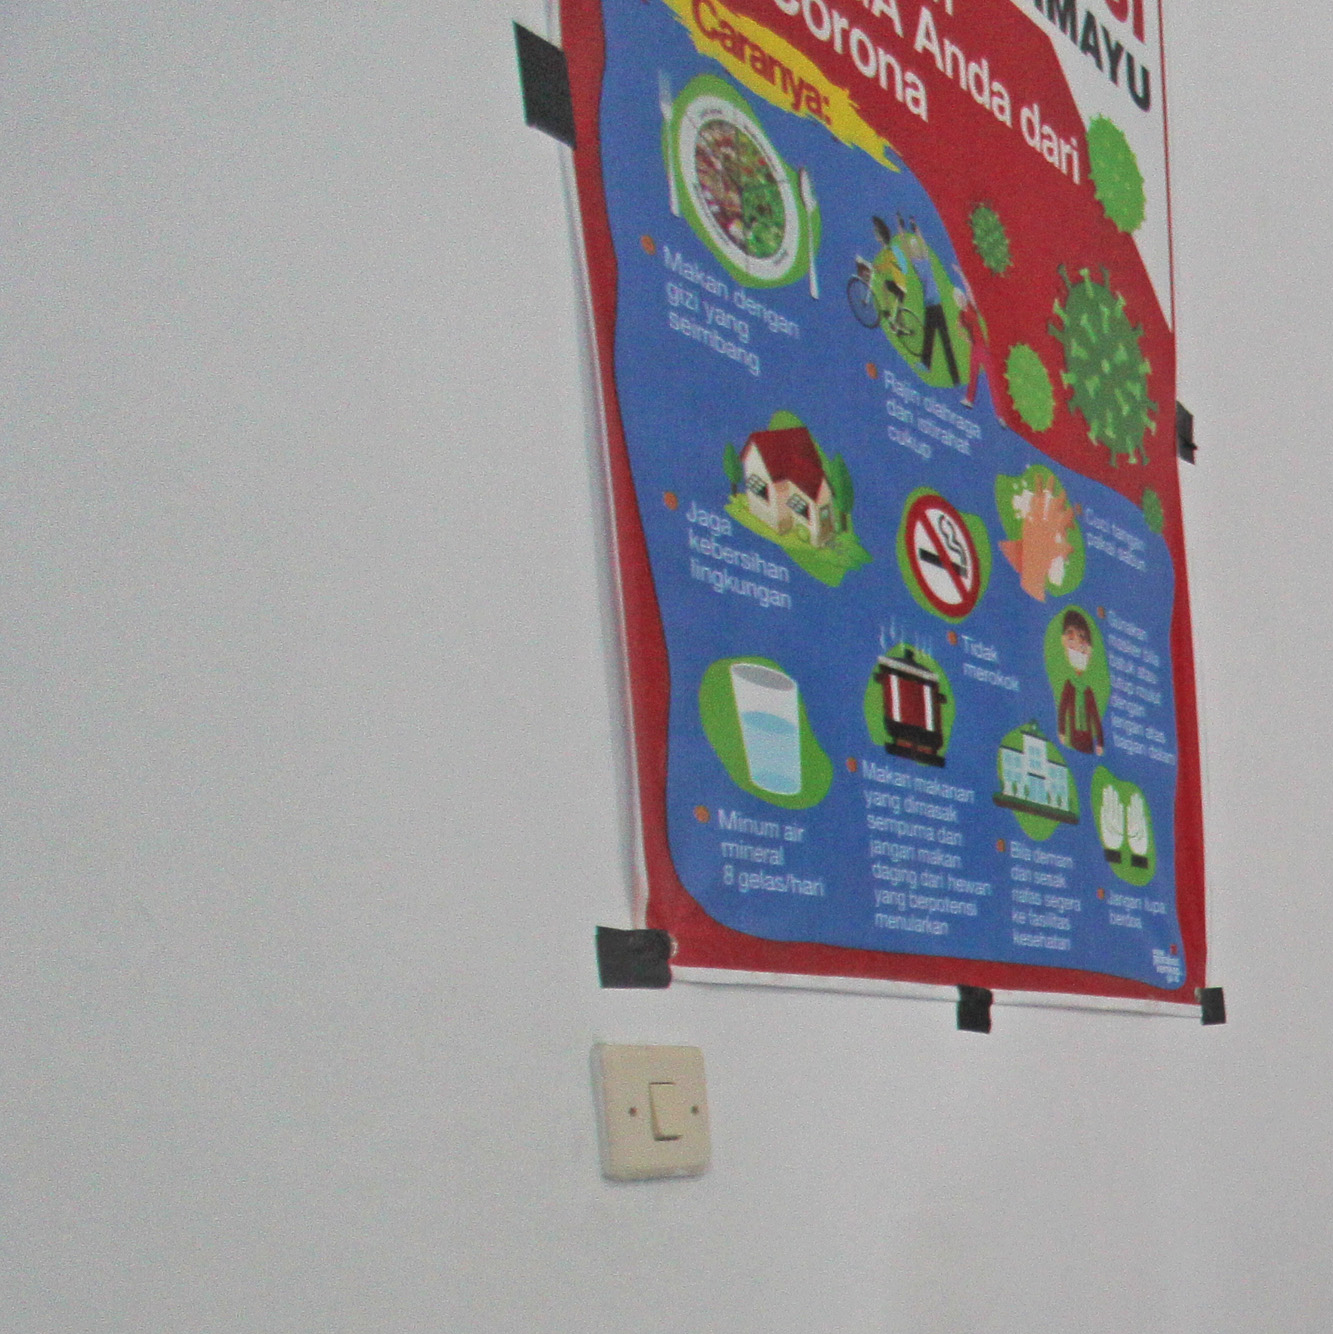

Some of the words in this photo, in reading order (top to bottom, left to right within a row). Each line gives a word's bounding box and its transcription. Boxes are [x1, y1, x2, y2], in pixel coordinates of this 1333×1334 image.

[692, 0, 832, 126] Caranya:
[1033, 0, 1151, 112] MAYU
[914, 6, 1012, 129] Anda
[1020, 102, 1080, 186] dari
[664, 244, 729, 300] Makan
[732, 289, 800, 339] dengan
[666, 281, 700, 312] gizi
[702, 299, 749, 344] yang
[669, 311, 761, 377] seimbang
[686, 500, 732, 537] Jaga
[688, 527, 790, 584] kebersihan
[690, 557, 792, 610] lingkungan
[862, 759, 911, 788] Makan
[913, 777, 976, 804] makanan
[718, 808, 781, 839] Minum
[783, 823, 805, 842] air
[720, 840, 785, 866] mineral
[723, 864, 735, 885] 8
[738, 869, 825, 897] gelas/hari
